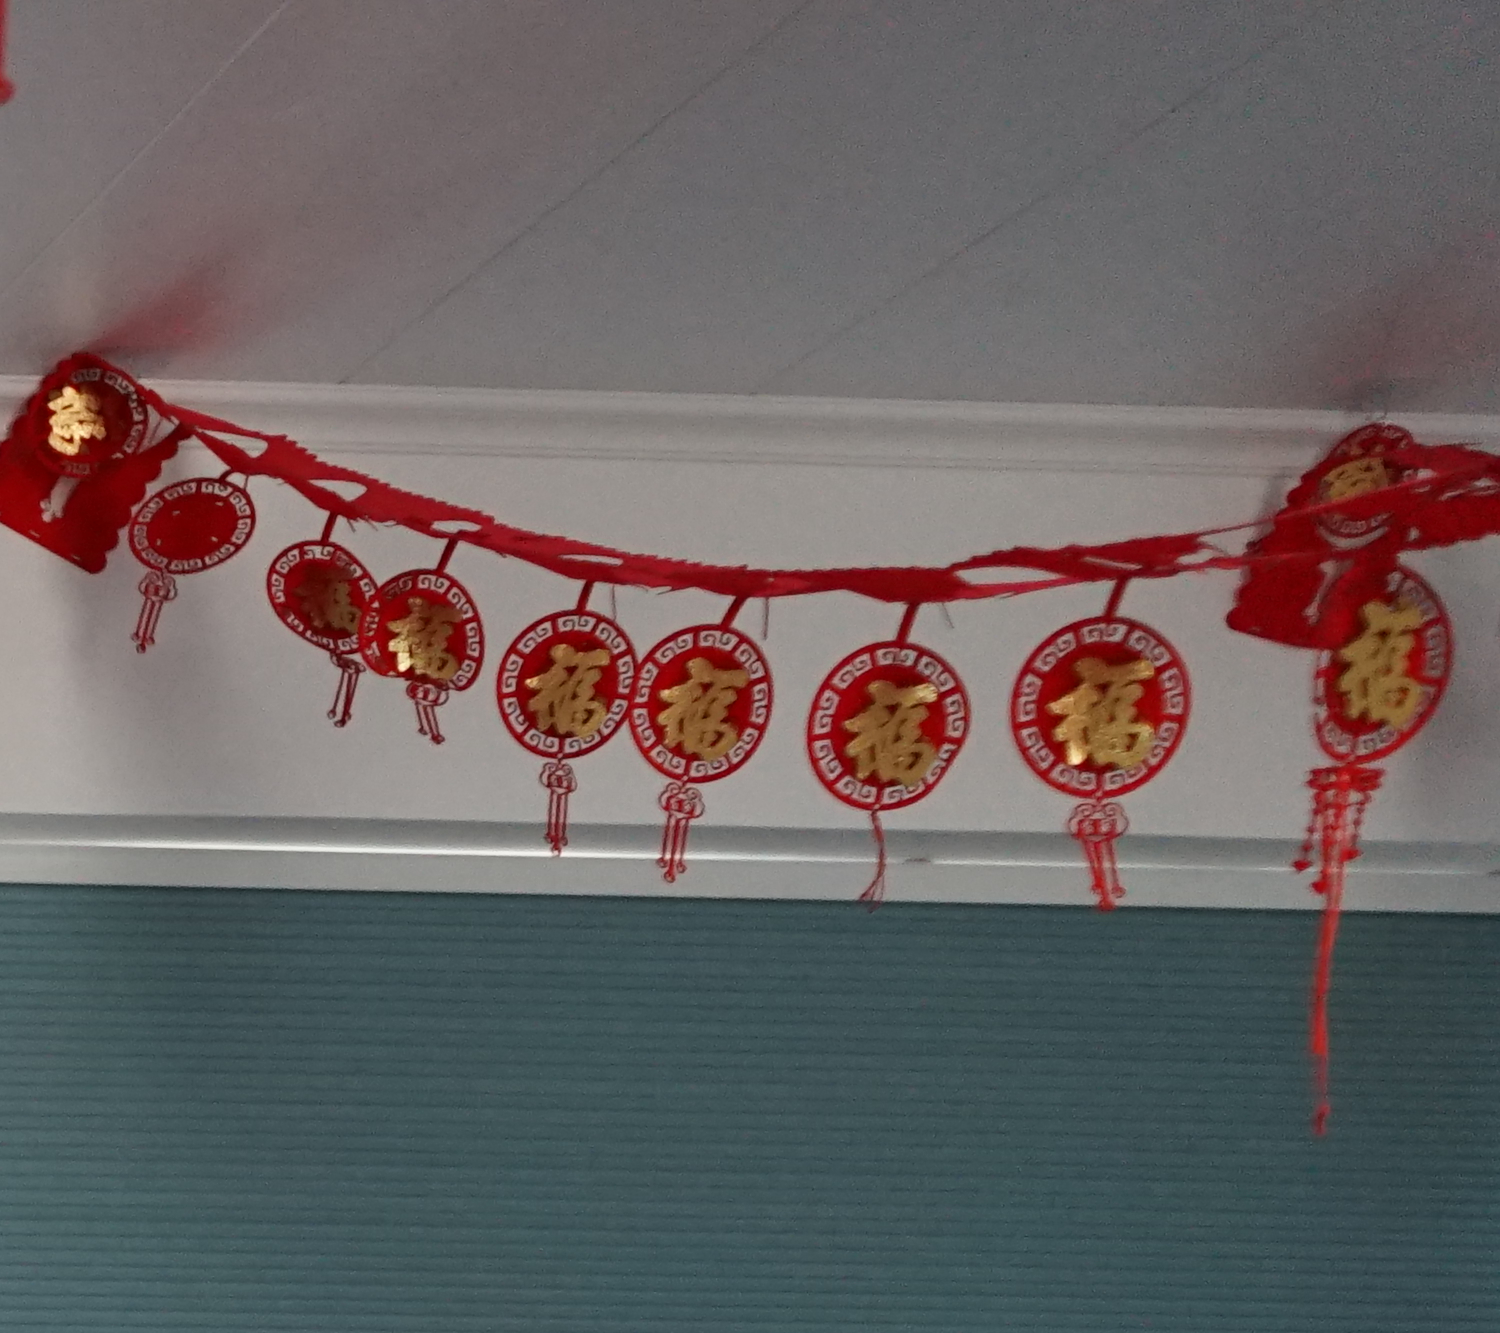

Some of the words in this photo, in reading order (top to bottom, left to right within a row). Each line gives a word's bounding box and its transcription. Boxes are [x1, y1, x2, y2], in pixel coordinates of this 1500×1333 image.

[385, 596, 462, 682] 福
[525, 642, 612, 738] 福
[1337, 599, 1427, 729] 福
[657, 656, 750, 762] 福
[840, 679, 940, 787] 福
[1046, 655, 1155, 768] 福
